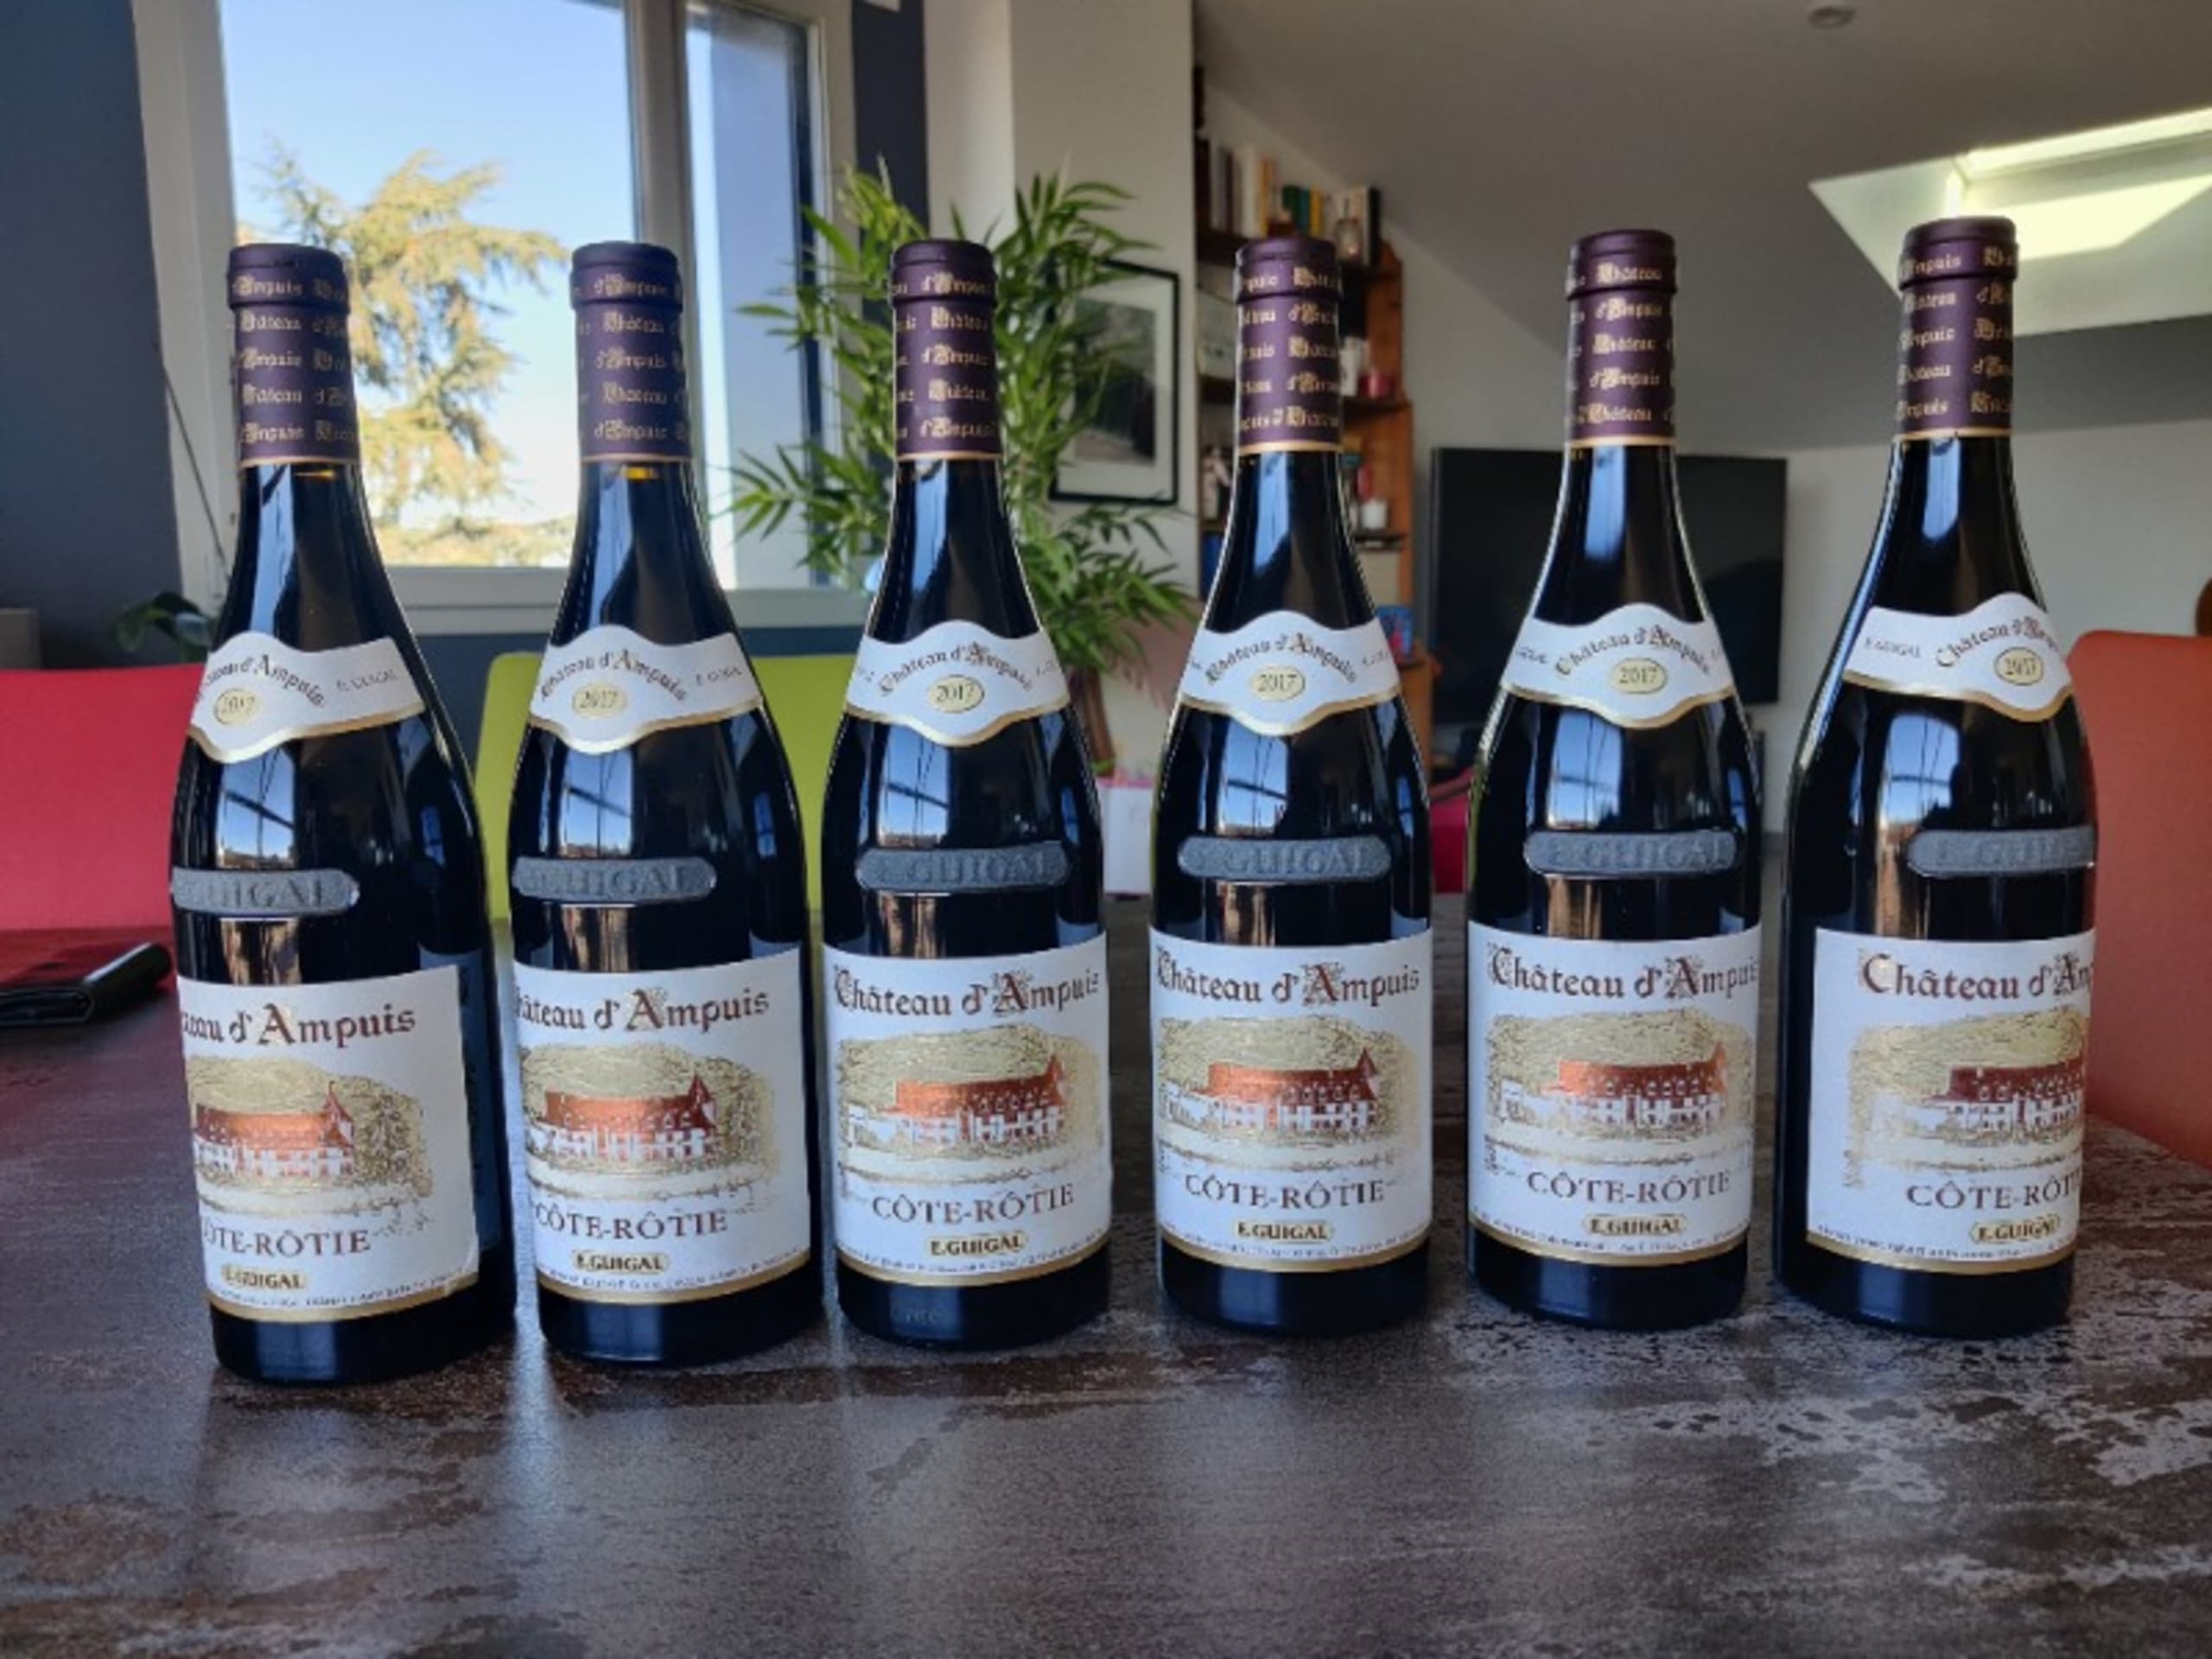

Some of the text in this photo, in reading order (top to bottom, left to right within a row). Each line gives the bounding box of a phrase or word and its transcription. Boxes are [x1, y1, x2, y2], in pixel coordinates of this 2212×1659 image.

[1257, 673, 1298, 692] 2017
[1618, 666, 1659, 684] 2017
[834, 965, 1099, 1017] Château d'Ampuis
[1156, 946, 1421, 1007] Château d'Ampuis
[1489, 944, 1758, 1000] Château d'Ampui
[1860, 950, 2020, 1000] Château
[229, 1002, 416, 1048] d'Ampuis
[594, 988, 770, 1033] d'Ampuis
[872, 1184, 1075, 1224] CÔTE-RÔTIE
[1185, 1173, 1385, 1210] CÔTE-RÔTIE
[1526, 1168, 1731, 1204] CÔTE-RÔTIE
[1906, 1168, 2081, 1210] CÔTE-RÔT
[535, 1202, 728, 1239] CÔTE-RÔTIE
